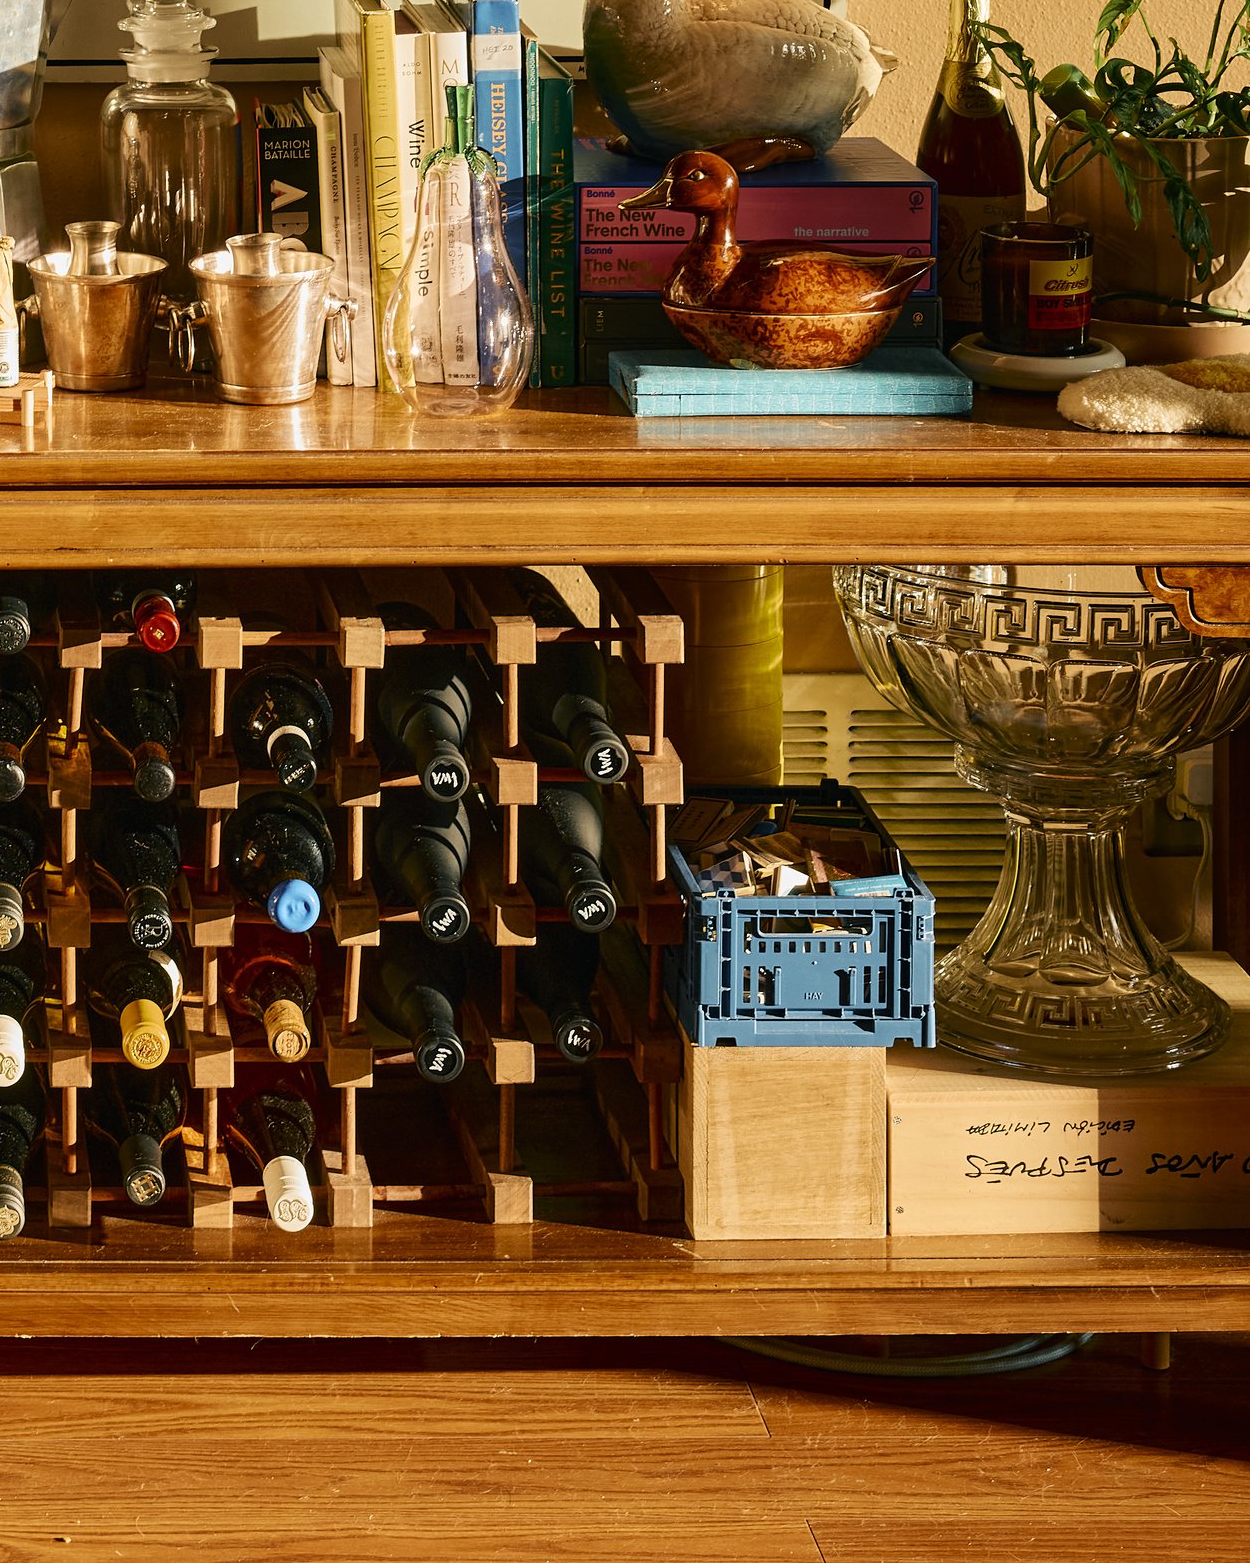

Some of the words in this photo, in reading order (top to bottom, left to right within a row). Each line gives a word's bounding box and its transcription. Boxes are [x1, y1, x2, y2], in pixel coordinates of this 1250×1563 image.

[490, 82, 508, 155] HEISEY
[264, 139, 311, 150] MARION
[408, 119, 425, 169] Wine
[264, 149, 311, 160] BATAILLE
[330, 145, 339, 204] CHAMPAGNE
[550, 149, 565, 191] THE
[586, 189, 615, 198] Bonné
[585, 208, 616, 222] The
[619, 208, 656, 222] New
[550, 202, 565, 259] WINE
[585, 223, 639, 237] French
[643, 223, 686, 237] Wine
[794, 226, 814, 237] the
[816, 226, 870, 237] narrative
[584, 246, 613, 255] Bonné
[414, 230, 434, 297] Simple
[584, 258, 613, 272] The
[1044, 272, 1089, 292] Citrush
[550, 271, 565, 317] LIST
[805, 992, 824, 1001] HAY
